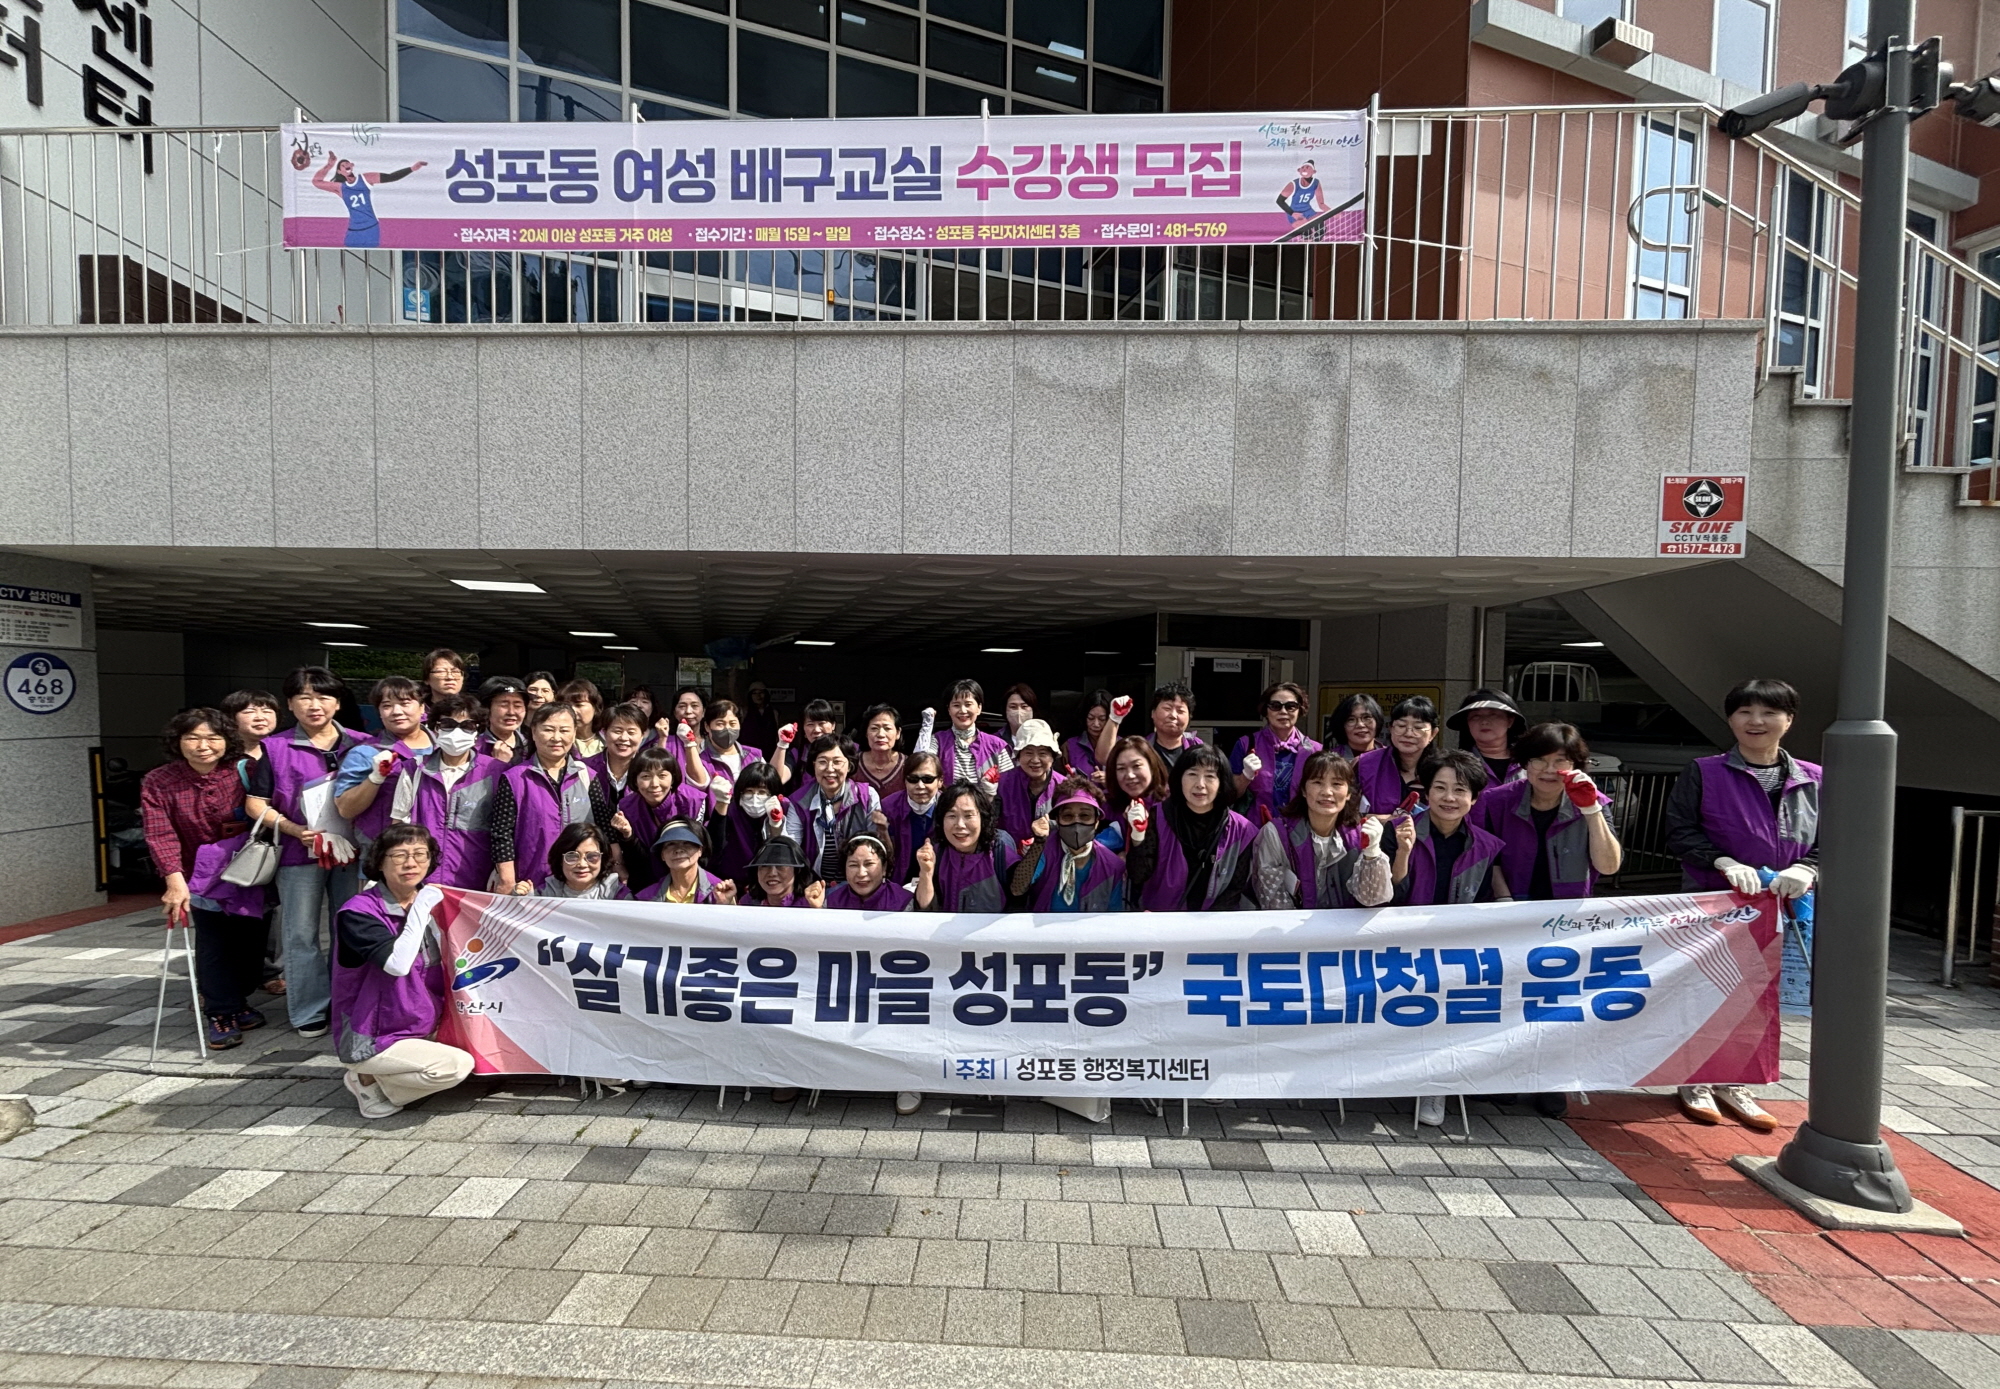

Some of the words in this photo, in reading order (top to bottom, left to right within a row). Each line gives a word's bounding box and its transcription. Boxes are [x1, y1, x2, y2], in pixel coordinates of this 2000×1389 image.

[1335, 133, 1364, 148] 안산
[446, 148, 600, 204] 성포동
[613, 147, 716, 204] 여성
[730, 145, 943, 203] 배구교실
[956, 142, 1119, 201] 수강생
[1132, 140, 1242, 198] 모집
[349, 192, 367, 209] 21
[1298, 192, 1312, 204] 15
[519, 228, 549, 243] 20세
[551, 228, 577, 243] 이상
[579, 228, 617, 243] 성포동
[619, 228, 645, 243] 거주
[647, 227, 673, 243] 여성
[755, 227, 781, 242] 매월
[783, 226, 811, 242] 15일
[825, 226, 851, 241] 말일
[935, 224, 975, 240] 성포동
[978, 223, 1056, 240] 주민자치센터
[1059, 223, 1081, 239] 3층
[1163, 222, 1227, 238] 481-5769
[1669, 521, 1696, 534] SK
[1697, 521, 1735, 534] ONE
[1678, 543, 1735, 554] 1577-4473
[28, 590, 71, 605] 설치안내
[17, 678, 64, 695] 468
[1542, 913, 1584, 938] 시민과
[814, 949, 934, 1025] 마을
[1182, 946, 1504, 1028] 국토대청결
[1521, 945, 1652, 1023] 운동
[456, 1001, 503, 1014] 안산시
[955, 1057, 996, 1081] 주최
[1016, 1057, 1077, 1081] 성포동
[1083, 1057, 1209, 1082] 행정복지센터
